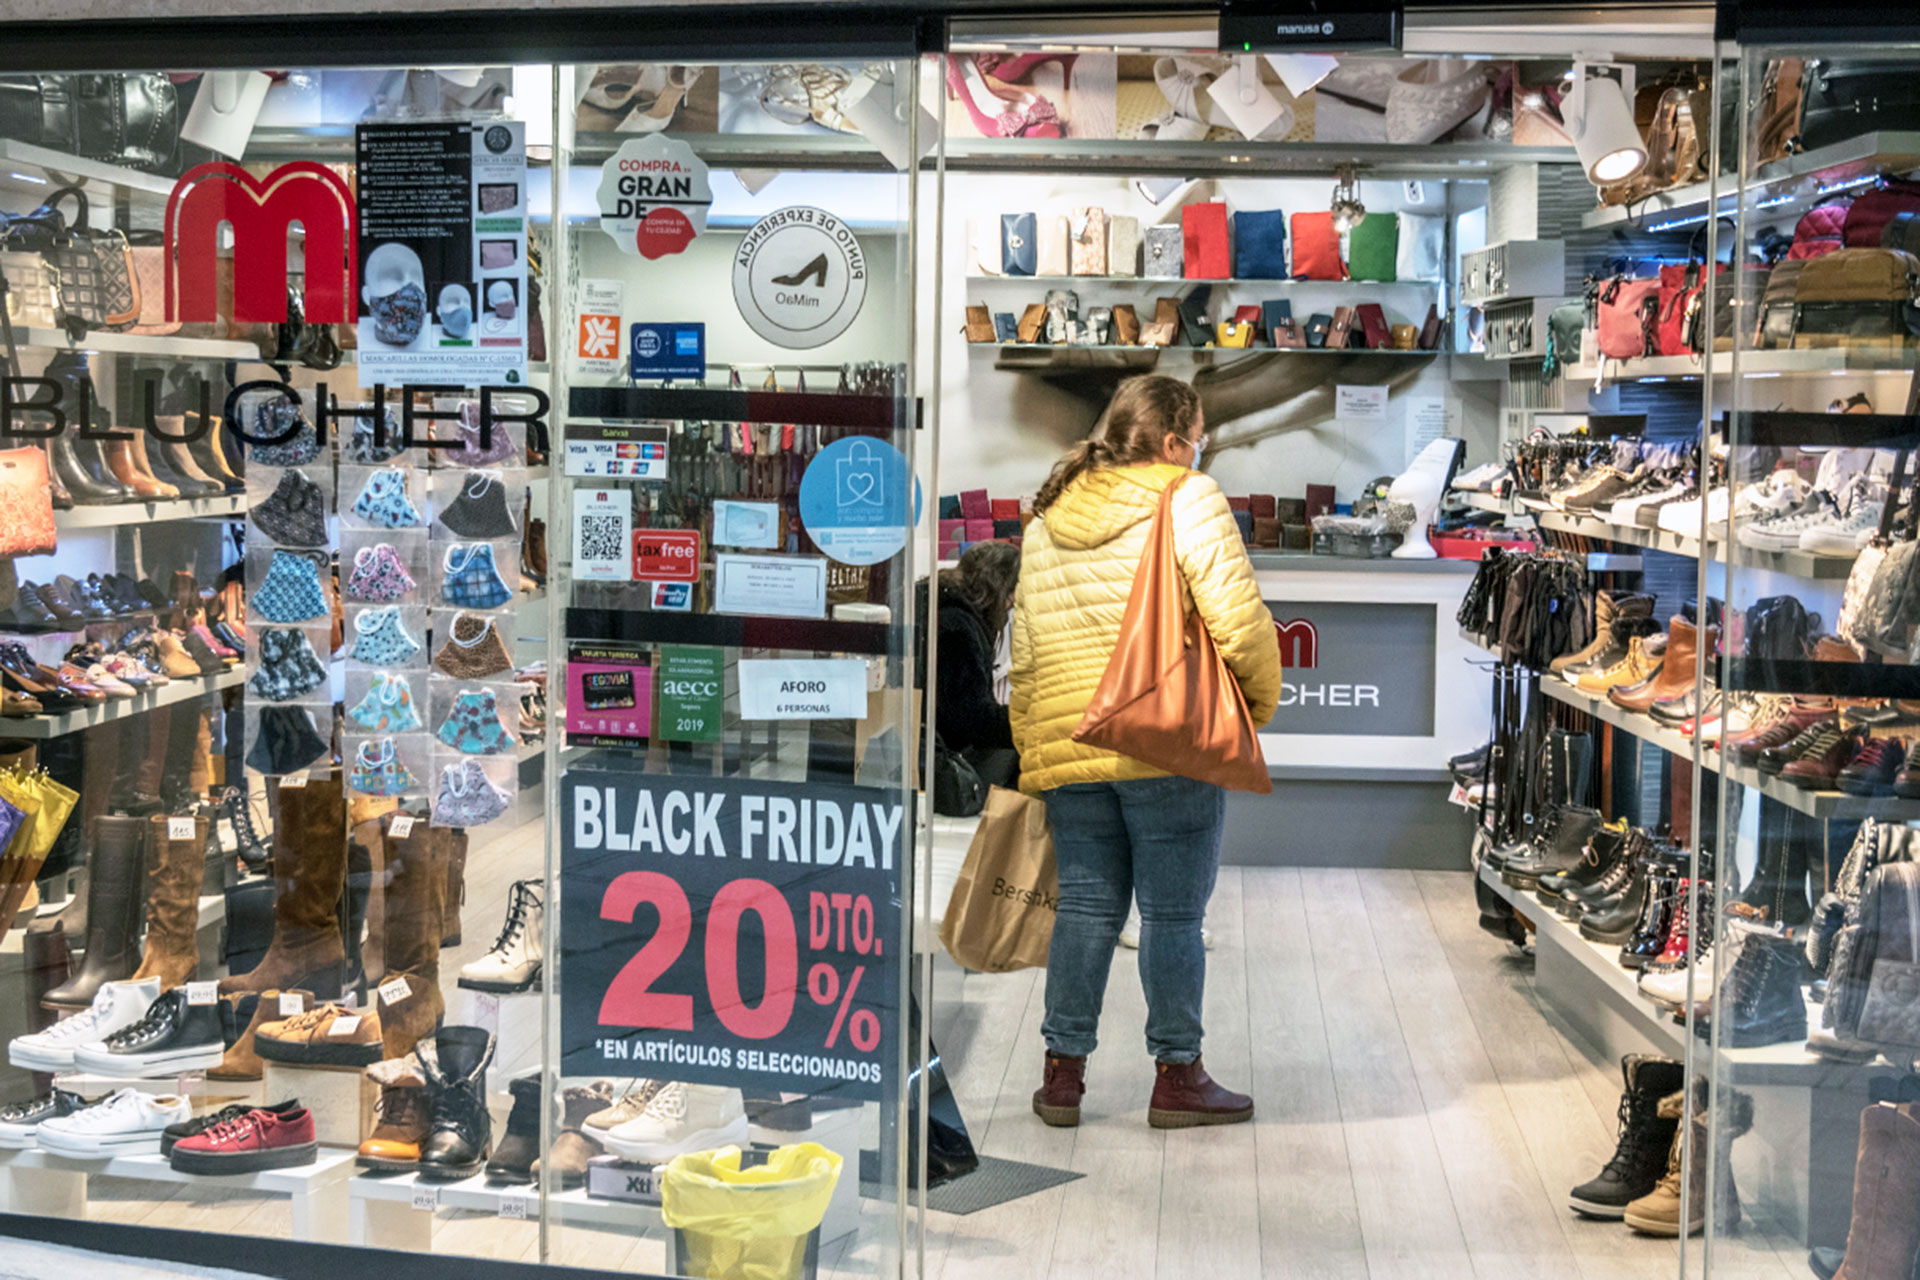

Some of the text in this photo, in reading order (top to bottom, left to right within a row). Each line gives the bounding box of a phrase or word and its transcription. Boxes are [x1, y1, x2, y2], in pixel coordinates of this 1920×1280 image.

[1277, 24, 1320, 35] manusa
[619, 160, 682, 173] COMPRA
[617, 176, 692, 198] GRAN
[616, 198, 648, 219] DE
[2, 375, 550, 453] BLUCHER
[569, 445, 588, 453] VISA
[594, 444, 613, 453] VISA
[663, 680, 718, 697] aecc
[780, 681, 827, 693] AFORO
[1278, 683, 1380, 707] CHER
[776, 704, 831, 713] 6 PERSONAS
[676, 718, 705, 732] 2019
[574, 785, 903, 870] BLACK FRIDAY
[809, 891, 883, 956] DTO.
[597, 870, 799, 1040] 20
[807, 961, 882, 1053] %
[632, 1038, 732, 1068] ARTÍCULOS
[736, 1053, 882, 1083] SELECCIONADOS
